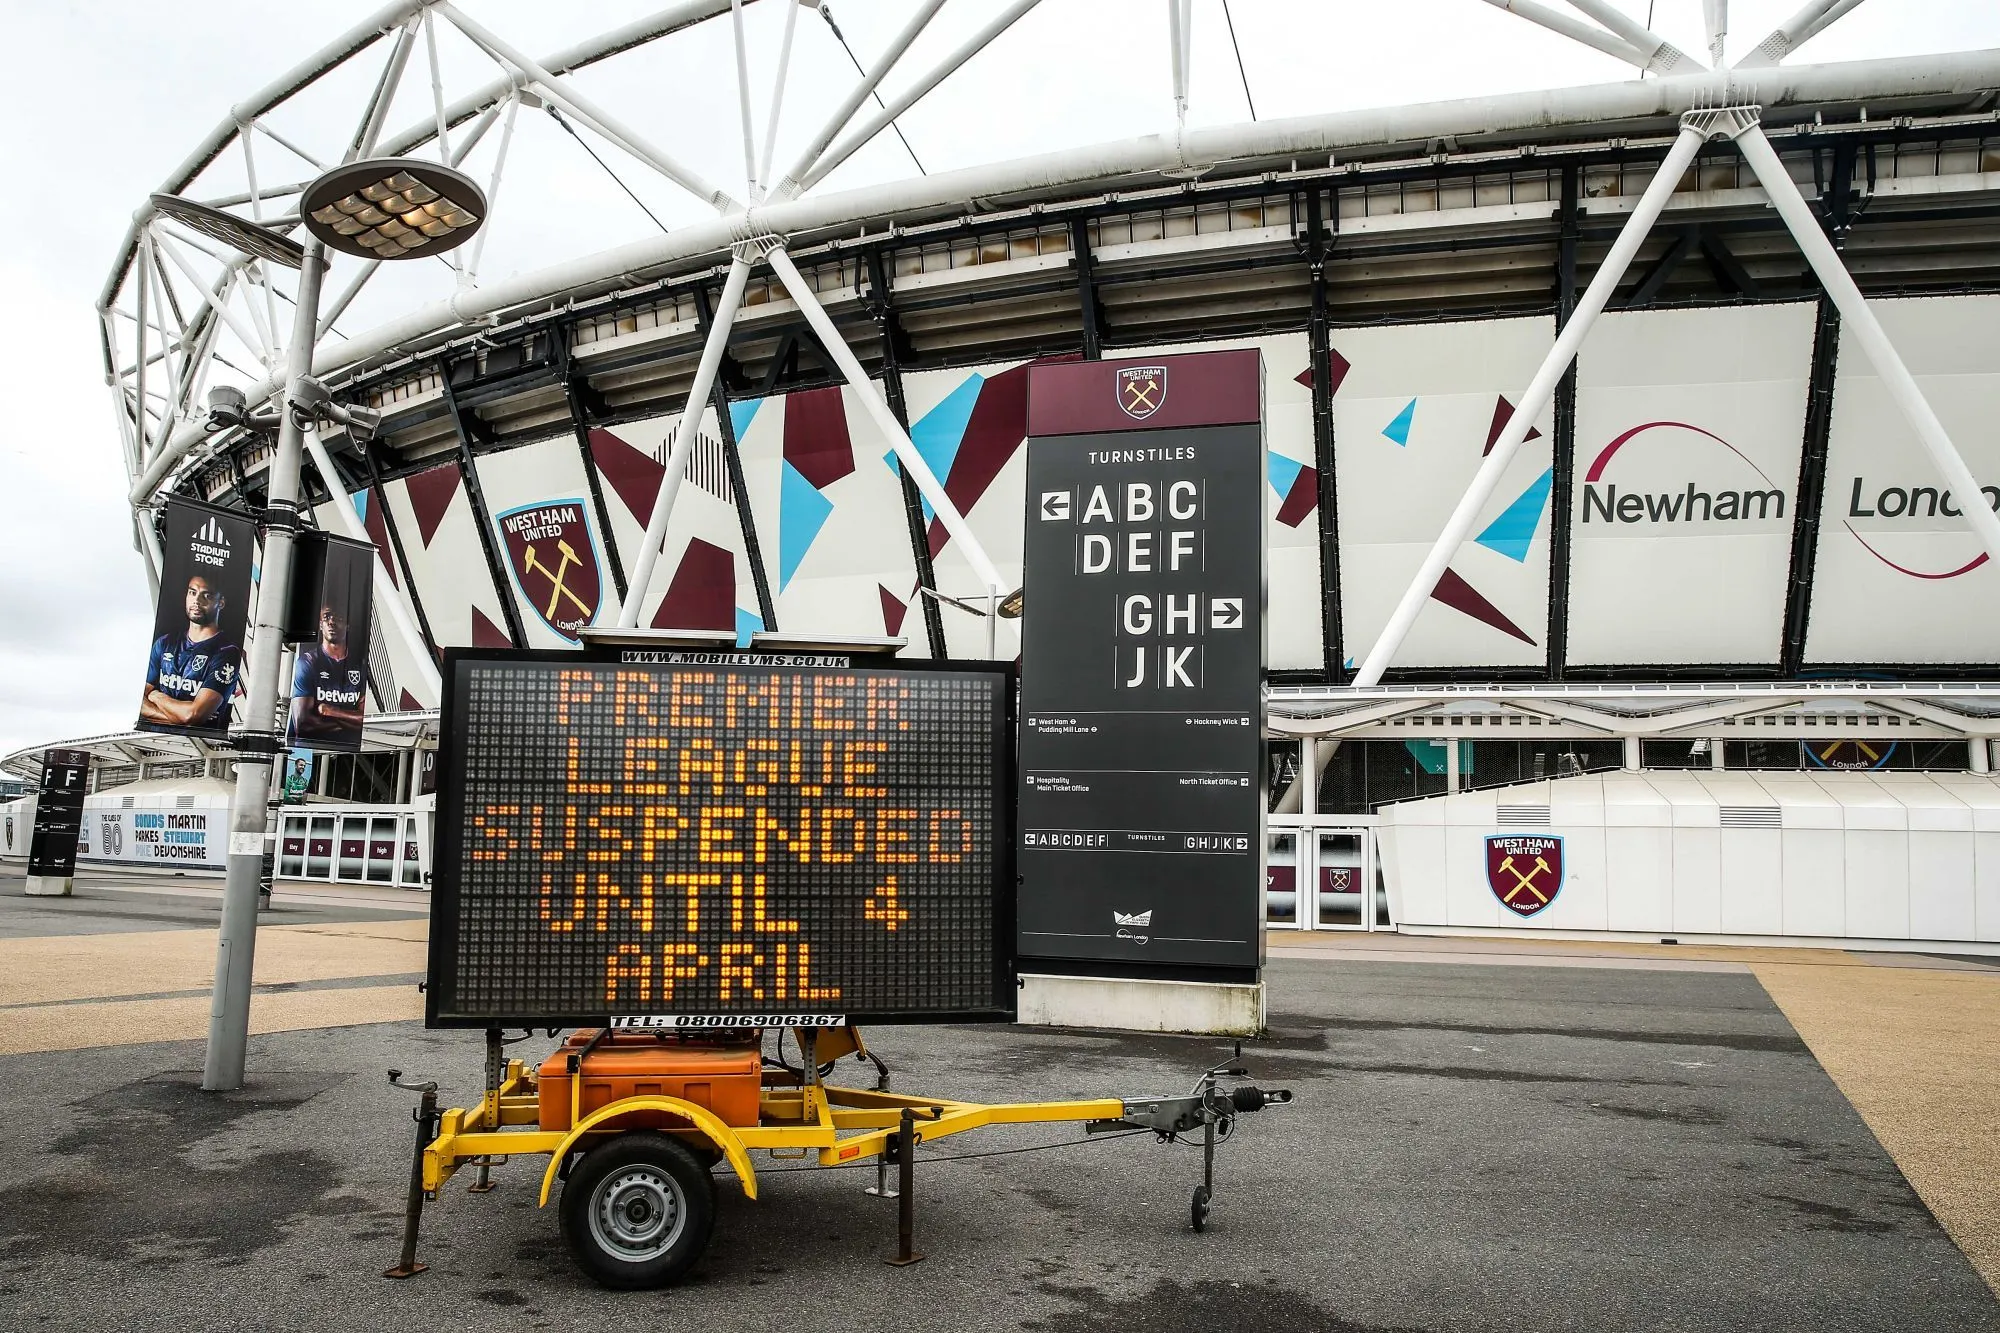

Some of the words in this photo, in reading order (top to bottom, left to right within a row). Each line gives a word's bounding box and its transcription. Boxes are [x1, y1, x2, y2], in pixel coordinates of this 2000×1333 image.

[1122, 370, 1142, 378] WEST
[1089, 447, 1195, 464] TURNSTILES
[1582, 482, 1785, 524] Newham
[506, 512, 538, 534] WEST
[540, 507, 577, 525] HAM
[521, 524, 563, 542] UNITED
[191, 542, 231, 559] STADIUM
[195, 553, 225, 567] STORE
[556, 617, 585, 631] LONDON
[622, 652, 848, 668] WWW.MOBILEVMS.CO.UK
[316, 687, 360, 706] betway
[558, 671, 909, 731] PREMIER
[1038, 726, 1062, 734] Pudding
[1194, 718, 1221, 726] Hackney
[567, 737, 888, 798] LEAGUE
[1832, 760, 1869, 769] LONDON
[44, 769, 52, 786] F
[65, 770, 78, 787] F
[1037, 777, 1070, 785] Hospitality
[135, 814, 165, 829] BONDS
[168, 815, 206, 830] MARTIN
[135, 830, 159, 843] PARKES
[163, 831, 206, 844] STEWART
[472, 805, 972, 865] SUSPENDED
[376, 846, 388, 855] high
[1493, 839, 1524, 849] WEST
[1527, 838, 1555, 849] HAM
[1506, 847, 1542, 855] UNITED
[154, 845, 207, 860] DEVONSHIRE
[541, 874, 798, 933] UNTIL
[865, 875, 909, 932] 4
[1511, 902, 1540, 910] LONDON
[606, 943, 841, 1001] APRIL
[612, 1016, 664, 1027] TEL:
[675, 1015, 844, 1027] 08006906867
